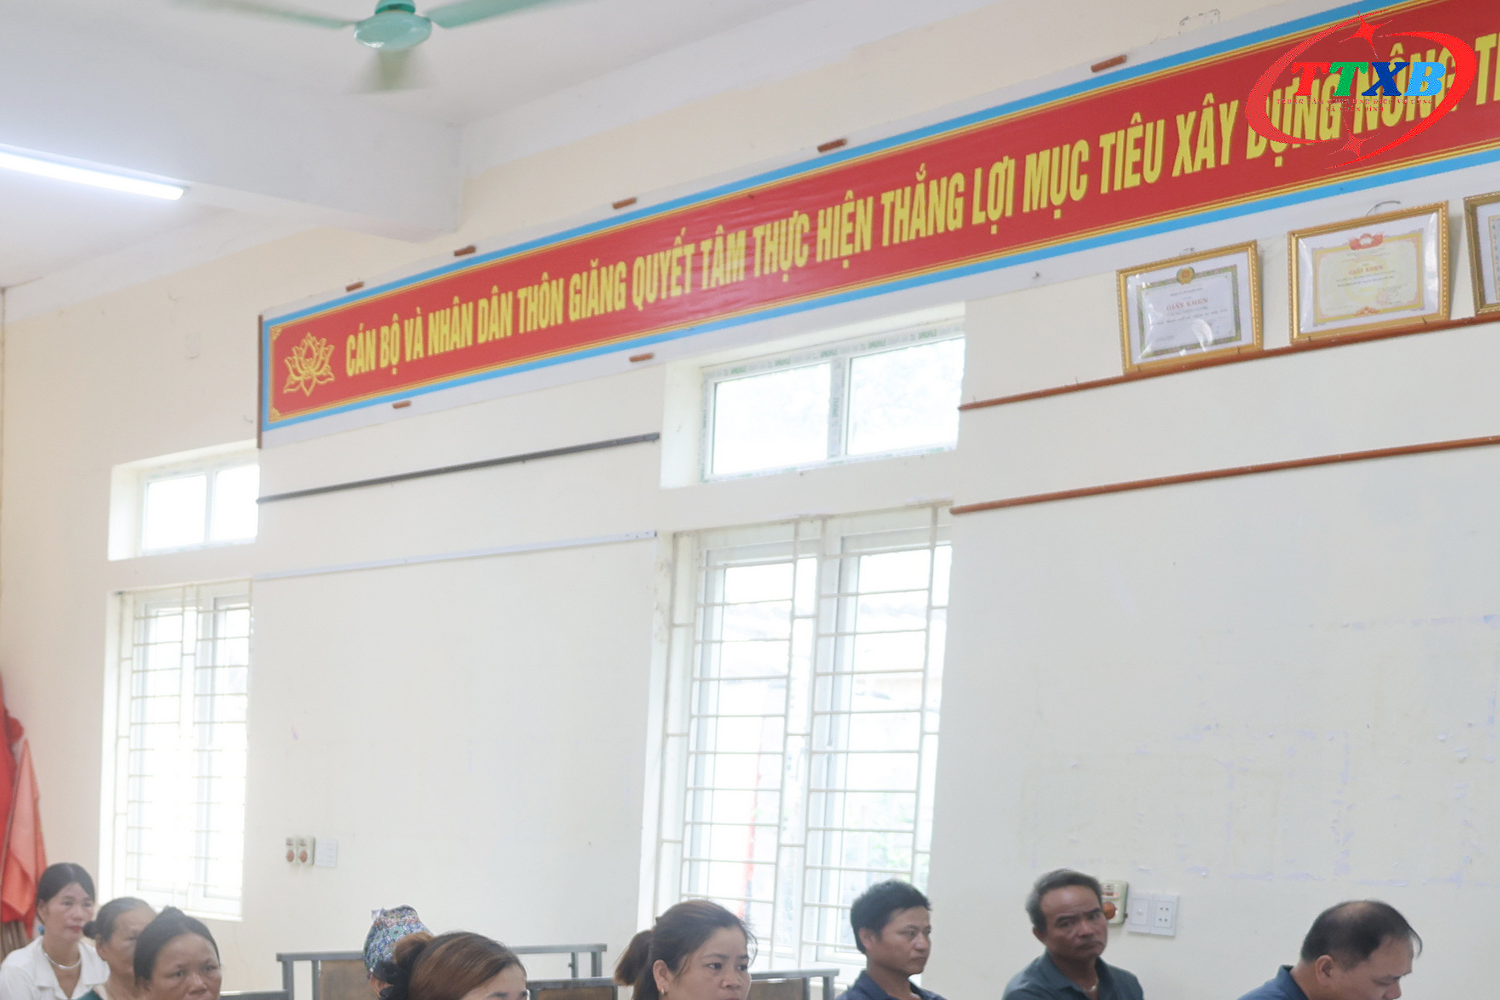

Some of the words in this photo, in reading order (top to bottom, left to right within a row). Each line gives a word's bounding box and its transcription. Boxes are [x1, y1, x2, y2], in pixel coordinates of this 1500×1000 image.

[346, 323, 377, 377] CÁN
[380, 314, 400, 375] BỘ
[404, 307, 424, 361] VÀ
[428, 296, 473, 355] NHÂN
[478, 286, 512, 343] DÂN
[518, 272, 564, 333] THÔN
[569, 259, 626, 321] GIĂNG
[632, 227, 695, 311] QUYẾT
[700, 225, 746, 290] TÂM
[753, 210, 810, 282] THỰC
[816, 190, 874, 268] HIỆN
[881, 163, 965, 246] THẮNG
[972, 155, 1016, 234] LỢI
[1023, 139, 1089, 219] MỤC
[1099, 112, 1165, 194] TIÊU
[1172, 93, 1239, 177] XÂY
[1475, 33, 1500, 105] T
